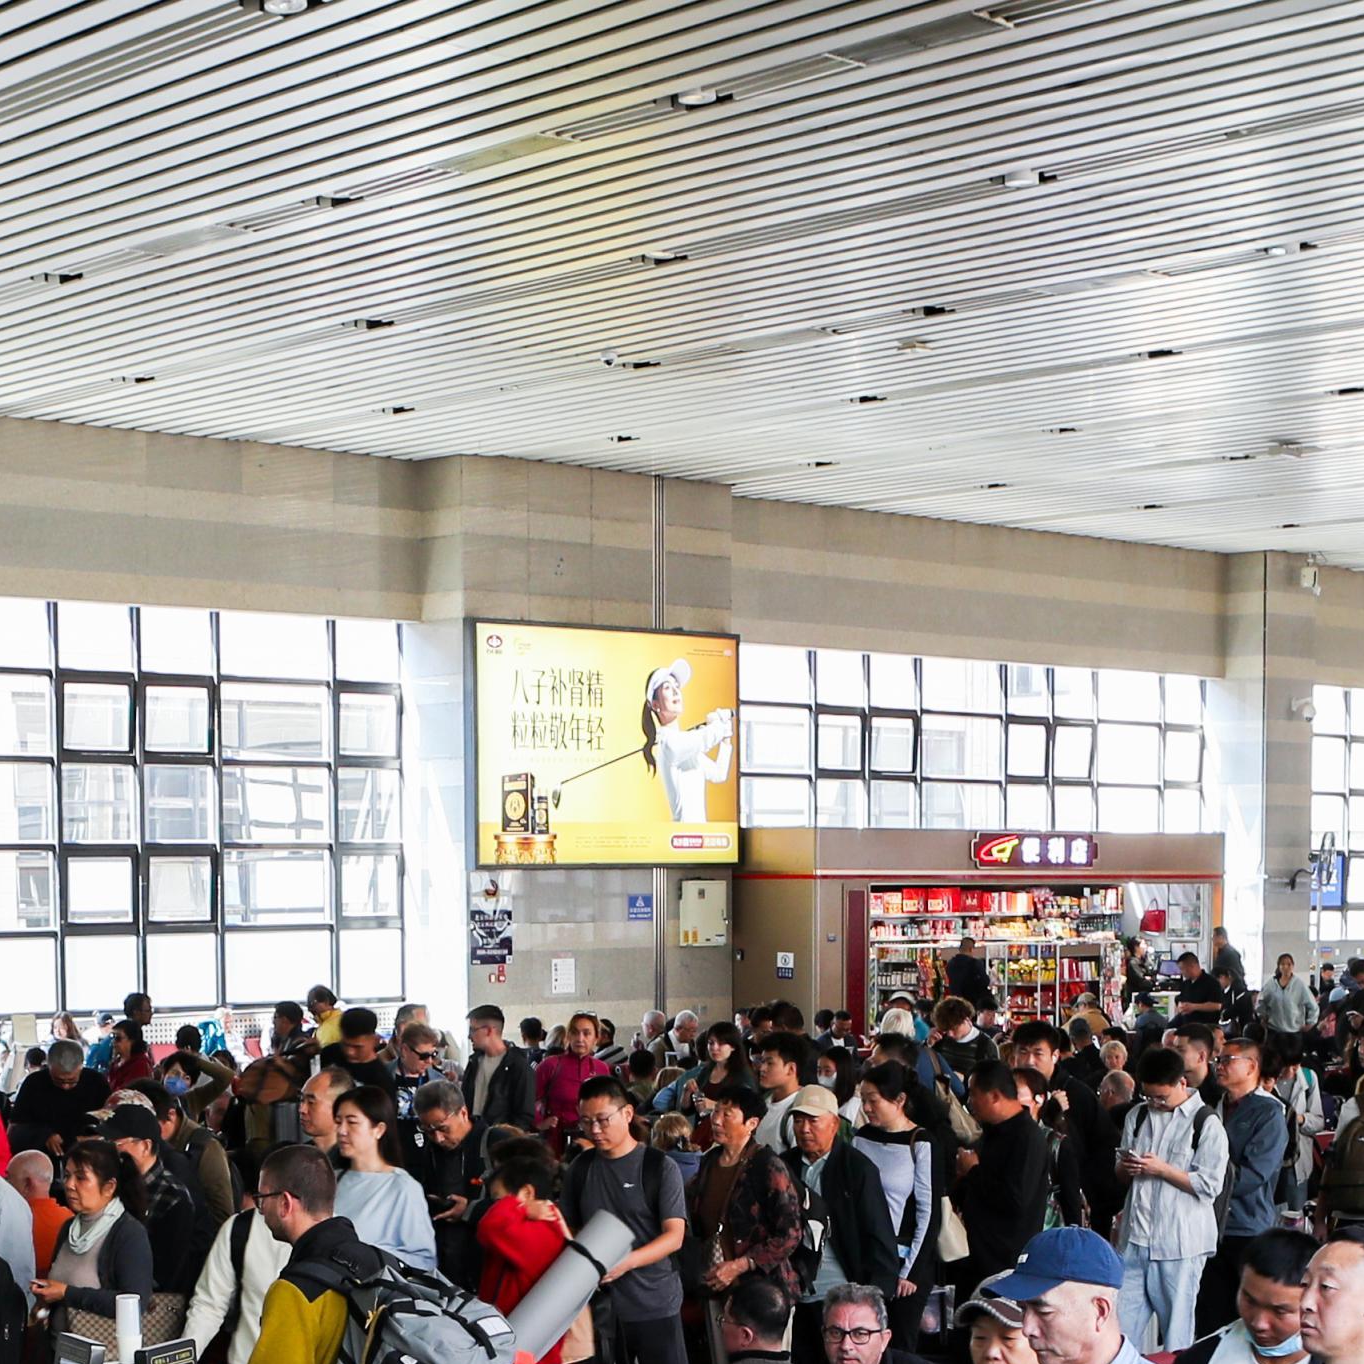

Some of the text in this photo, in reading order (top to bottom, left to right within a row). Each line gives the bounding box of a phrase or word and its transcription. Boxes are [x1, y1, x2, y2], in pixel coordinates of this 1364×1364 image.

[512, 667, 604, 707] 八子补肾精
[511, 711, 605, 751] 粒粒敬年轻
